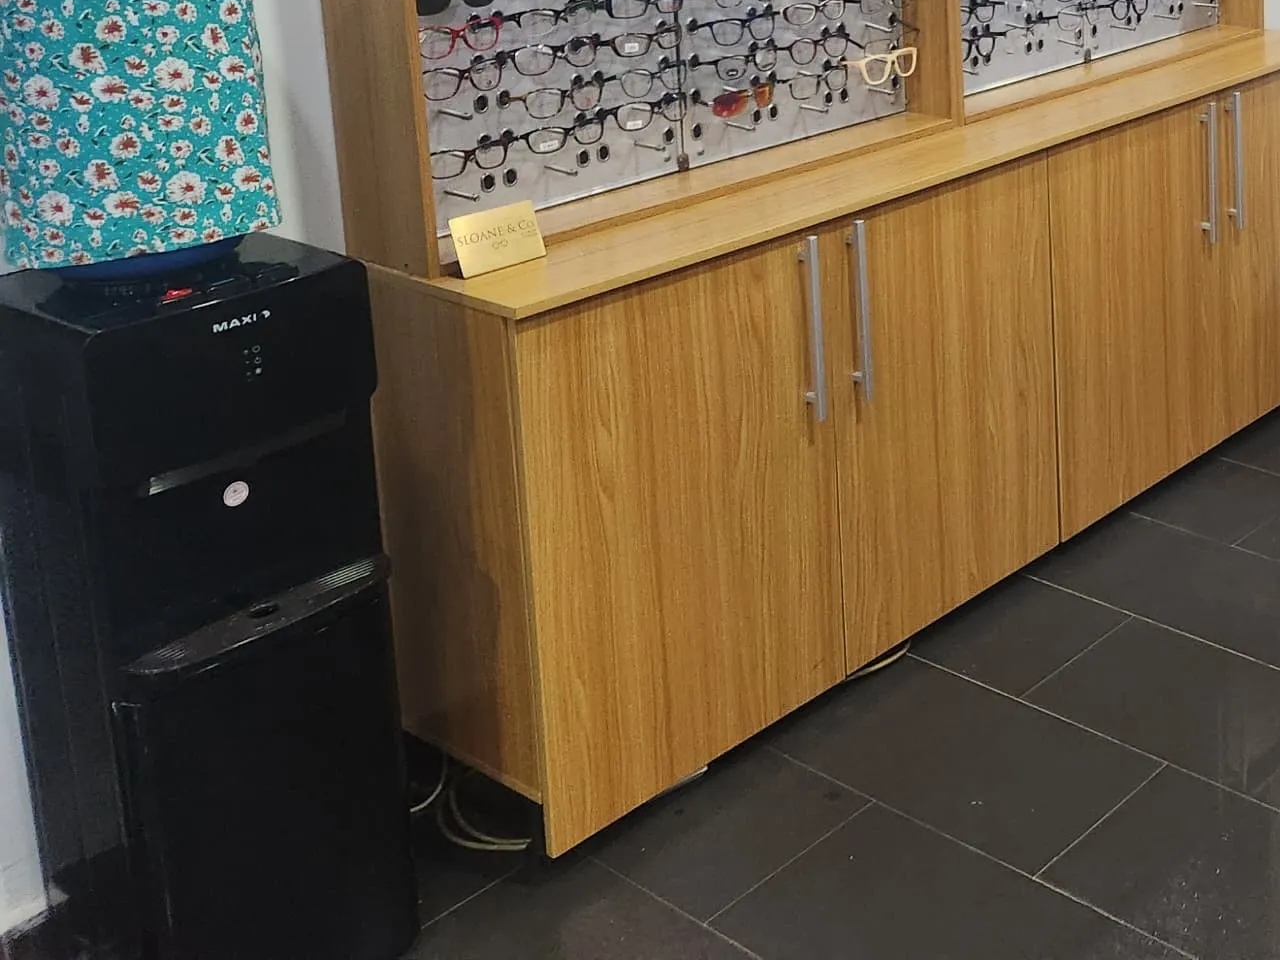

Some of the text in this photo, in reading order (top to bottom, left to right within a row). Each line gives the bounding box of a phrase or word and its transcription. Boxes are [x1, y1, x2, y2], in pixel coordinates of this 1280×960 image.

[456, 226, 503, 247] SLOANE
[507, 223, 517, 234] &
[212, 313, 257, 333] MAXI
